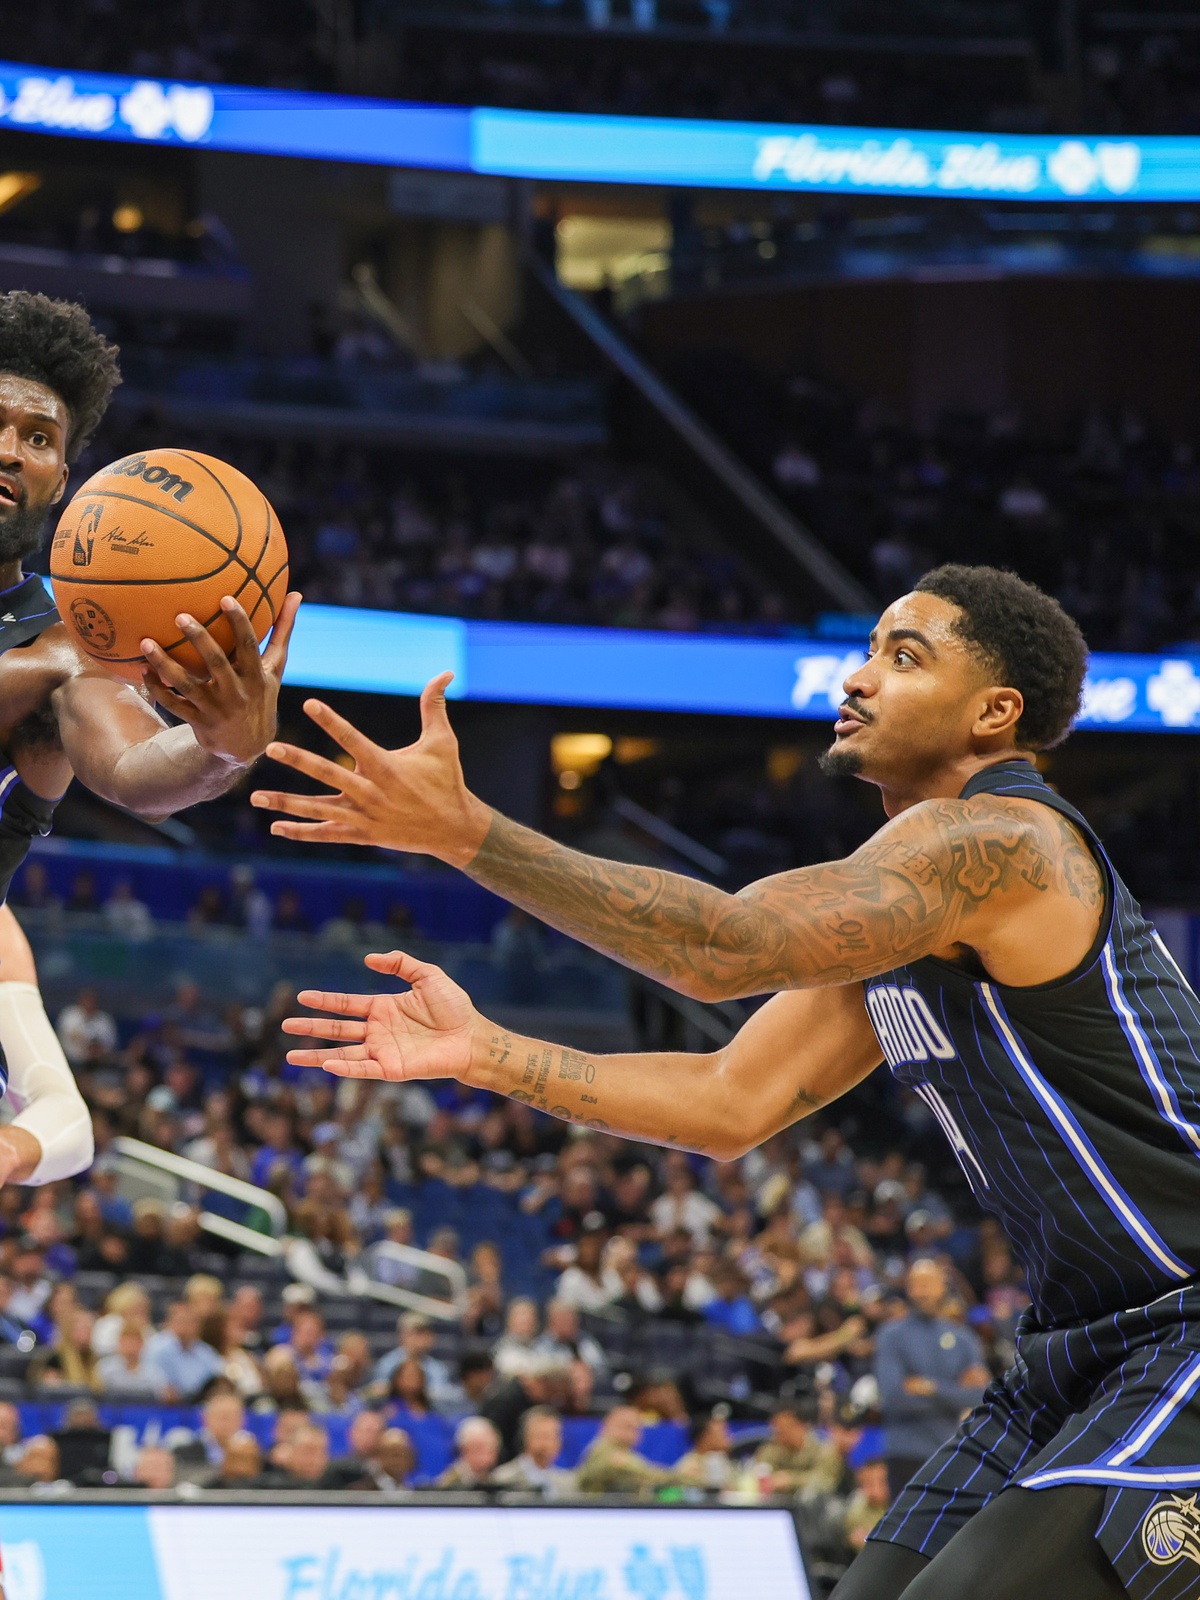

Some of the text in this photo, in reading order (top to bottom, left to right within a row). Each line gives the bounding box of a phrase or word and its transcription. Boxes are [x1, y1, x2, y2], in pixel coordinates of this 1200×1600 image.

[9, 77, 115, 132] Blue
[753, 133, 1040, 191] Florida Blue
[1077, 677, 1137, 723] ue
[865, 985, 957, 1071] ANDO
[282, 1545, 610, 1600] Florida Blue
